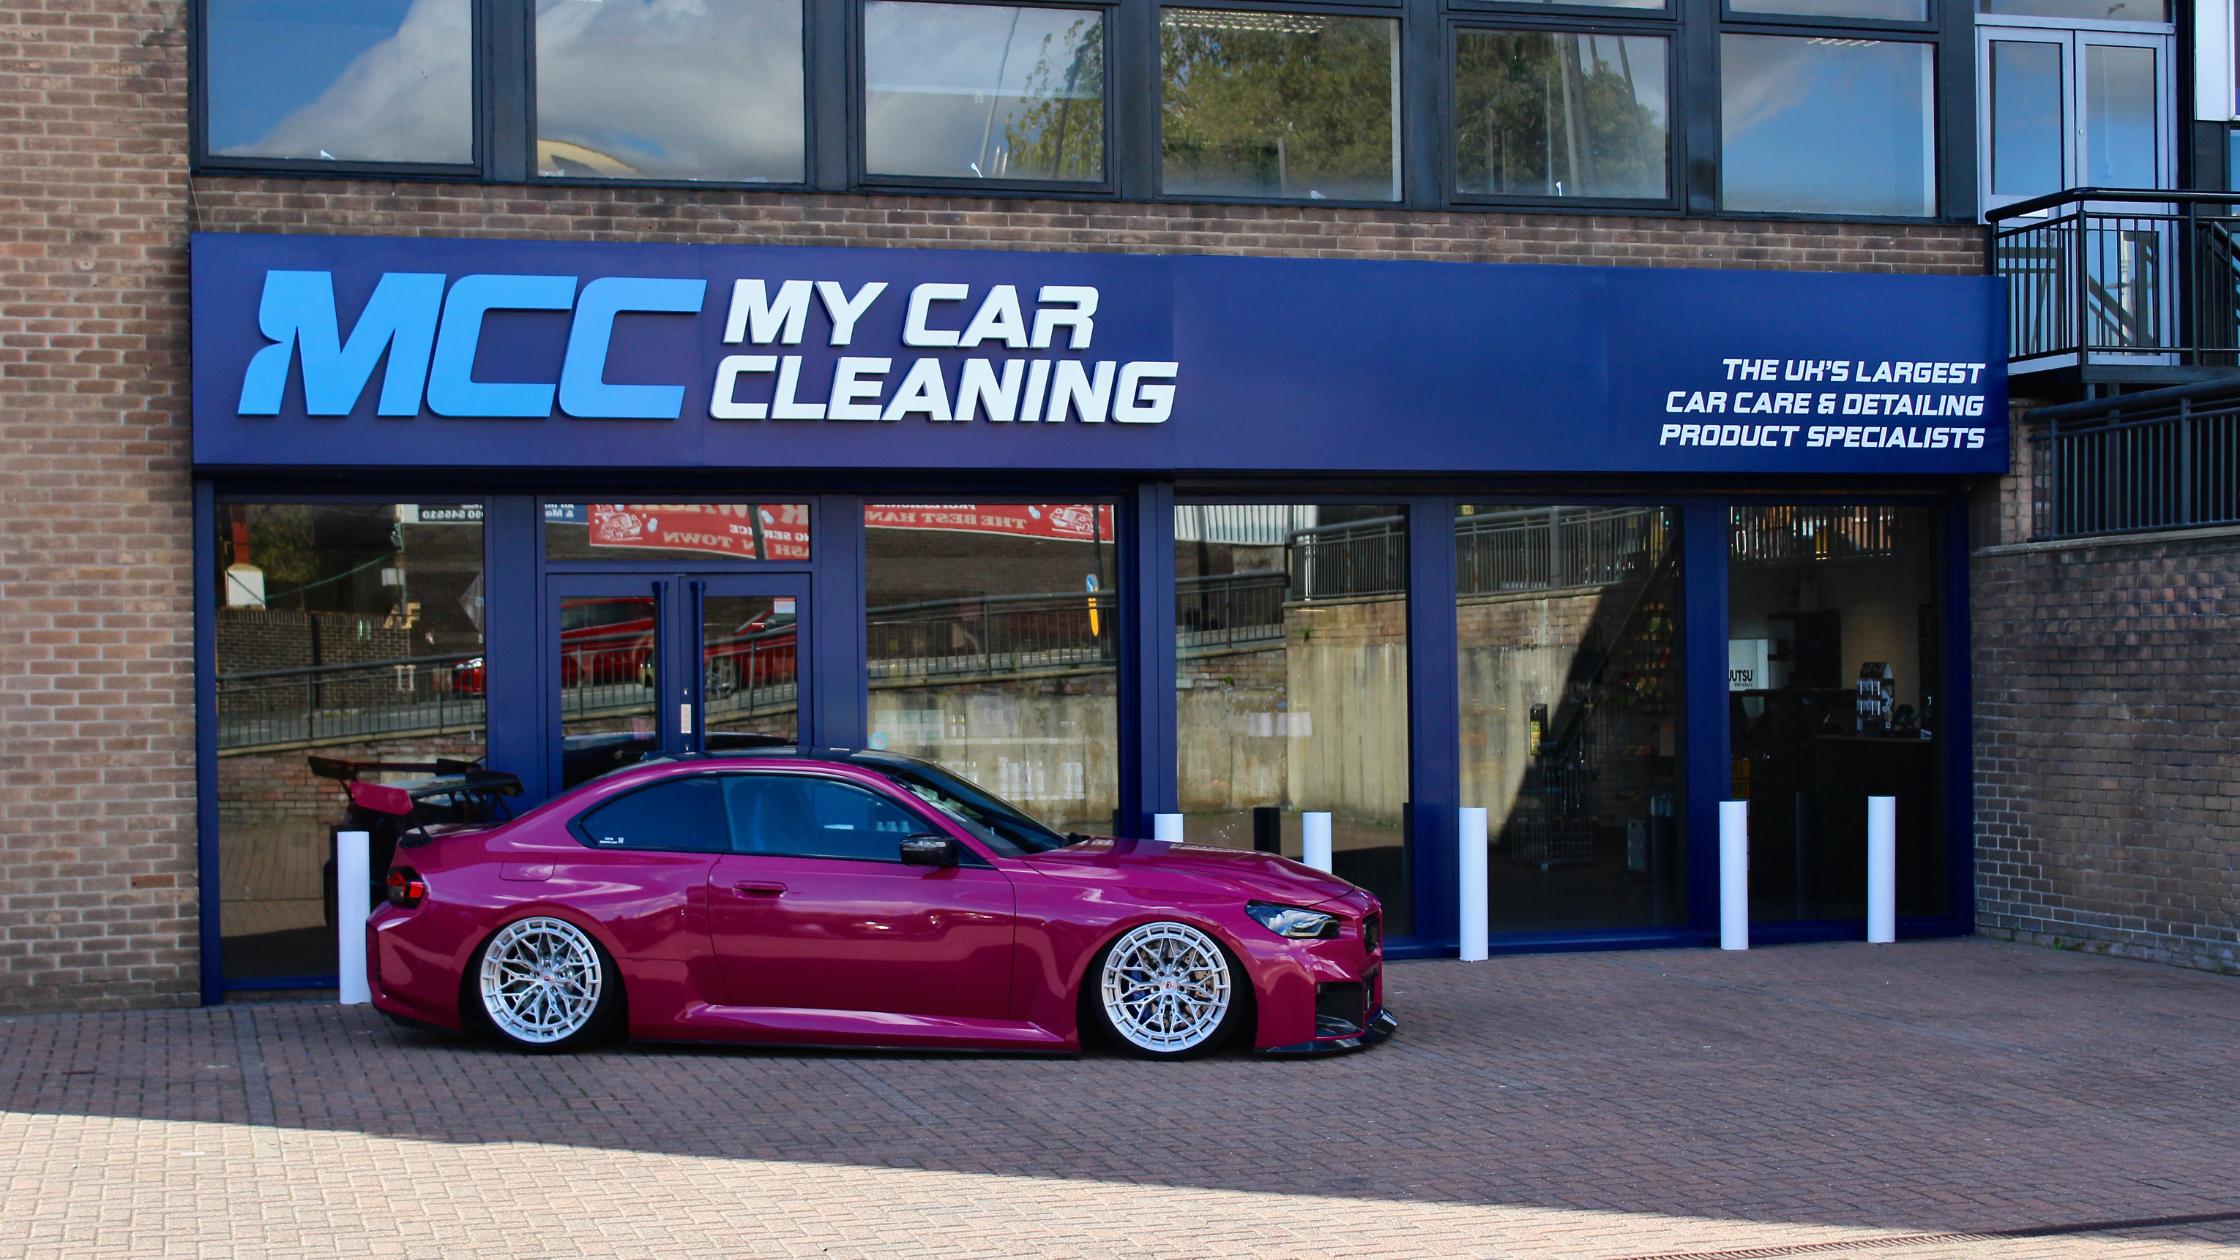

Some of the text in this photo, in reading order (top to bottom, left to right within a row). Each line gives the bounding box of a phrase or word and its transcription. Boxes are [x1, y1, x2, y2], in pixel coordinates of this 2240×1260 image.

[722, 279, 1100, 350] MY CAR
[238, 270, 708, 420] MCC
[709, 354, 1180, 424] CLEANING
[1723, 359, 1778, 381] THE
[1856, 361, 1986, 385] LARGEST
[1666, 391, 1985, 416] CAR CARE & DETAILING
[1660, 424, 1986, 449] PRODUCT SPECIALISTS
